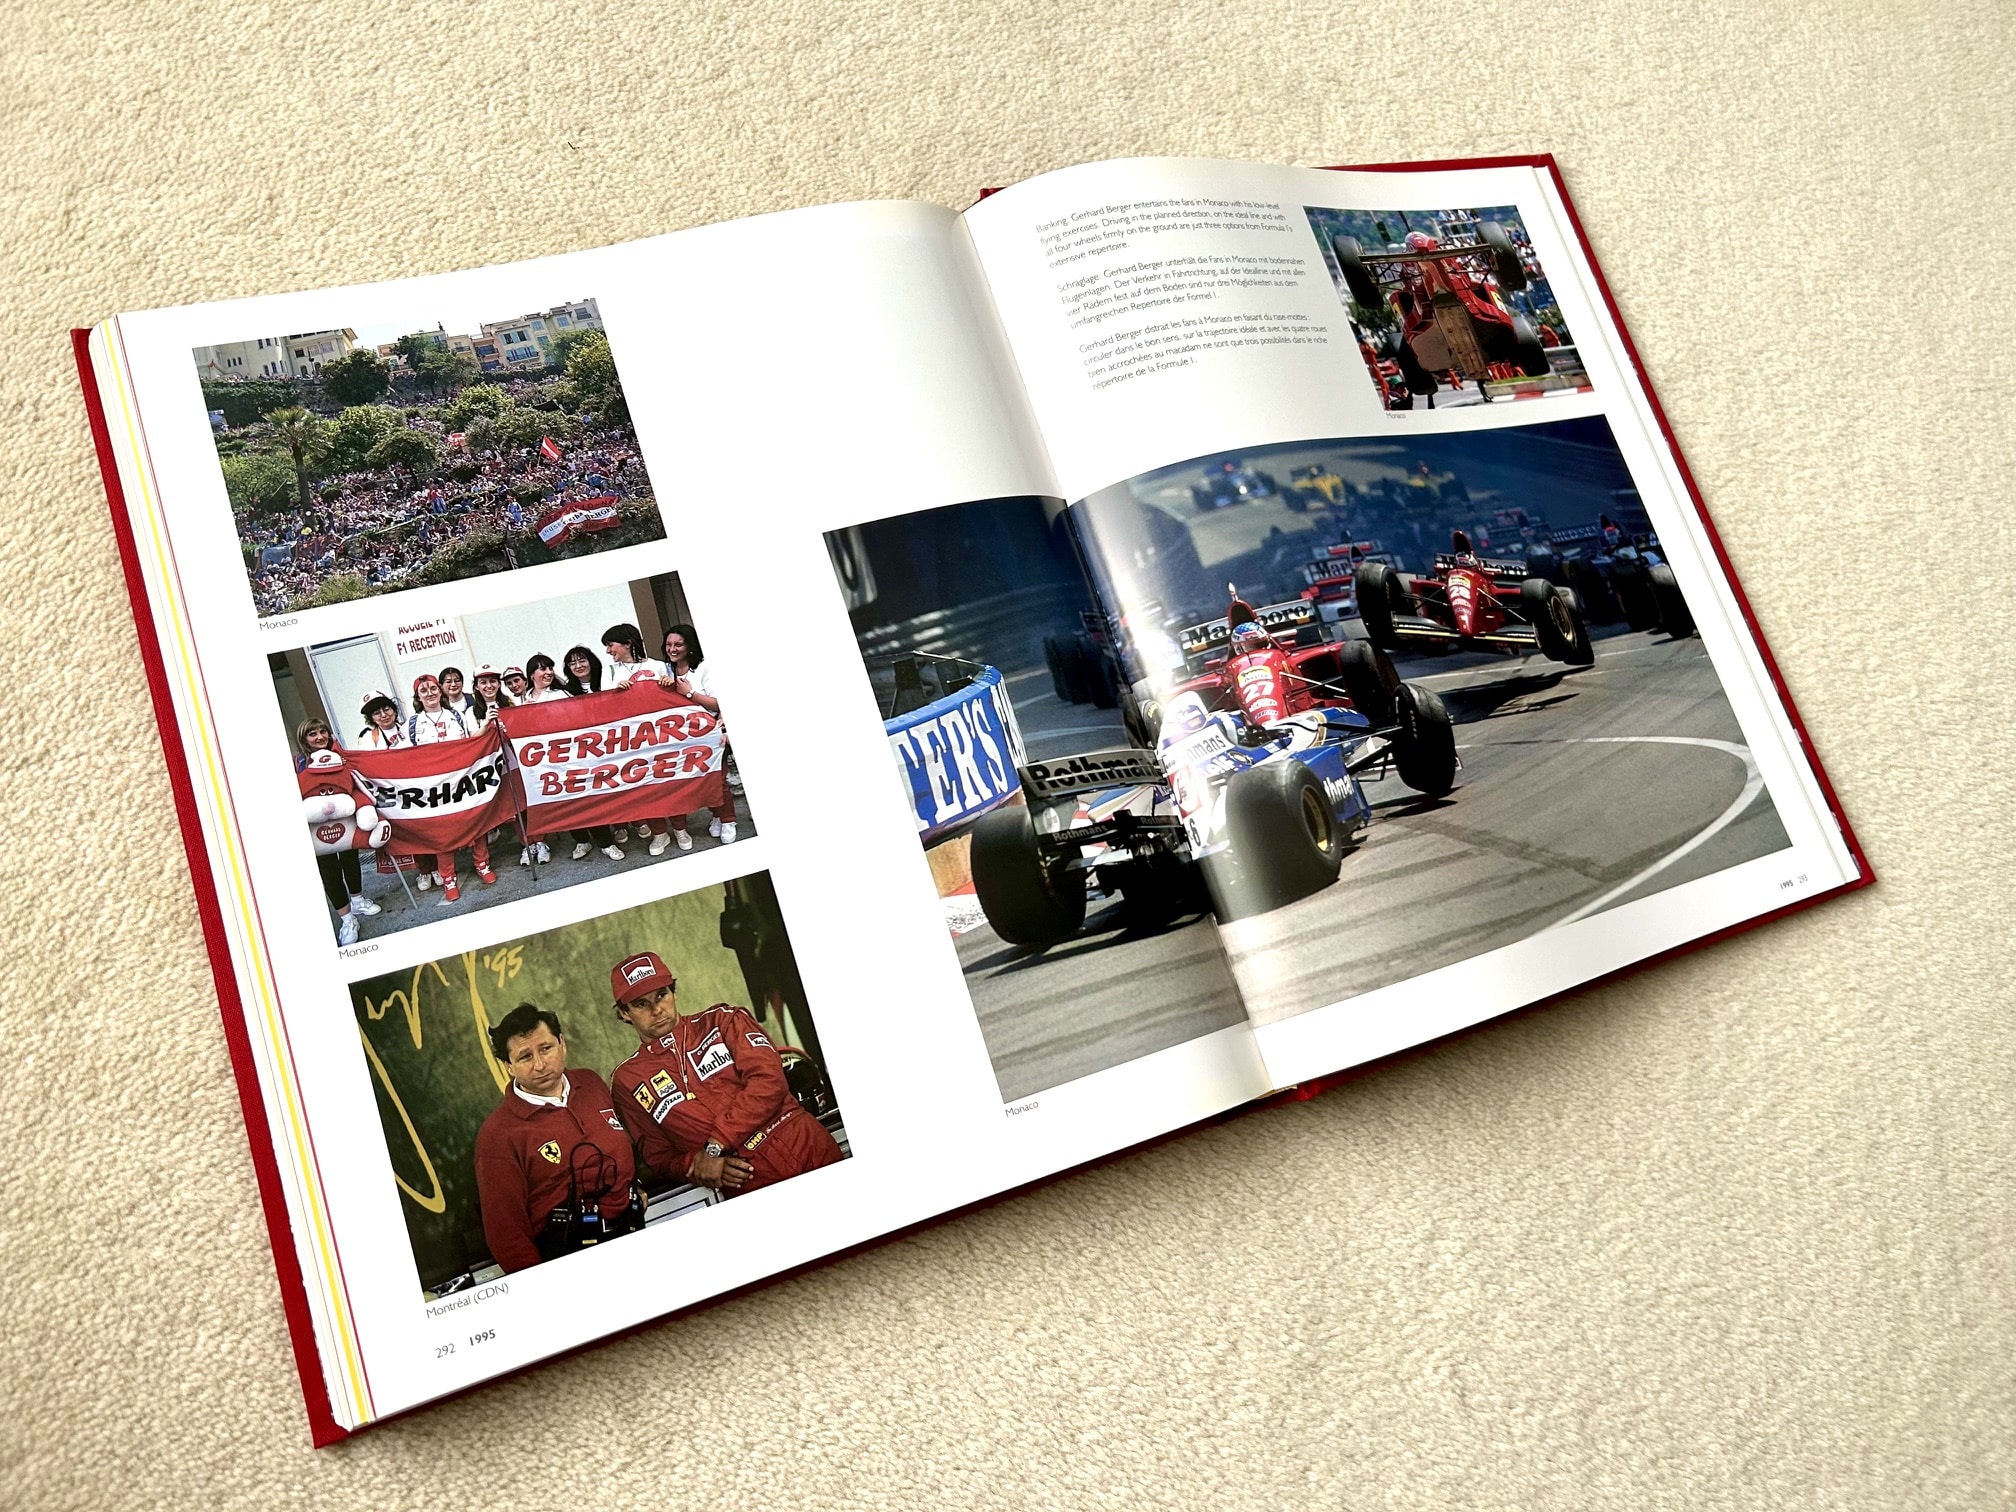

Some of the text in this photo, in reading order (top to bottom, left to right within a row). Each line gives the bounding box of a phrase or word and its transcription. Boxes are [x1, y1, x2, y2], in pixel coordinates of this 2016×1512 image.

[1071, 206, 1105, 221] Gerhard
[1106, 203, 1131, 214] Berger
[1134, 199, 1169, 210] entertains
[1181, 198, 1195, 207] fans
[1196, 198, 1202, 206] in
[1203, 199, 1229, 207] Monaco
[1101, 216, 1131, 227] Driving
[1139, 212, 1152, 220] the
[1154, 210, 1181, 221] planned
[1223, 211, 1234, 219] the
[1249, 211, 1260, 220] line
[1261, 212, 1272, 220] and
[1055, 243, 1072, 254] four
[1073, 234, 1102, 248] wheels
[1103, 228, 1125, 239] firmly
[1138, 225, 1151, 233] the
[1152, 223, 1178, 234] ground
[1179, 222, 1191, 230] are
[1191, 221, 1204, 231] just
[1204, 221, 1221, 229] three
[1222, 221, 1245, 230] options
[1245, 222, 1261, 231] from
[1049, 251, 1086, 269] extensive
[1103, 263, 1137, 278] Gerhard
[1138, 260, 1163, 271] Berger
[1165, 256, 1197, 268] unterhält
[1197, 255, 1208, 264] die
[1208, 255, 1224, 264] Fans
[1225, 256, 1231, 264] in
[1231, 255, 1258, 265] Monaco
[1258, 256, 1268, 264] mit
[1113, 278, 1131, 289] Der
[1131, 273, 1162, 285] Verkehr
[1219, 267, 1230, 275] auf
[1231, 267, 1241, 275] der
[1269, 267, 1281, 276] und
[1066, 306, 1081, 317] vier
[1114, 292, 1129, 302] fest
[1130, 287, 1142, 299] auf
[1143, 285, 1162, 296] dem
[1162, 281, 1188, 292] Boden
[1188, 278, 1202, 289] sind
[1203, 279, 1215, 288] nur
[1216, 277, 1230, 287] drei
[1273, 278, 1284, 287] aus
[1285, 279, 1299, 287] dem
[1070, 305, 1129, 330] umfangreichen
[1130, 297, 1171, 311] Repertoire
[1172, 294, 1185, 303] der
[1186, 291, 1212, 302] Formel
[1079, 335, 1115, 354] Gerhard
[1115, 328, 1143, 342] Berger
[1144, 322, 1170, 334] distrait
[1170, 320, 1182, 329] les
[1182, 318, 1197, 327] fans
[1198, 317, 1204, 325] à
[1204, 315, 1233, 325] Monaco
[1233, 314, 1243, 322] en
[1264, 313, 1273, 321] du
[1083, 351, 1113, 366] circuler
[1115, 344, 1134, 356] dans
[1135, 341, 1143, 349] le
[1144, 337, 1161, 348] bon
[1183, 331, 1194, 340] sur
[1196, 329, 1203, 338] la
[1203, 326, 1238, 338] trajectoire
[1281, 324, 1291, 333] les
[1291, 326, 1309, 334] quatre
[1154, 351, 1164, 359] au
[1165, 342, 1202, 356] macadam
[1203, 342, 1213, 350] ne
[1214, 339, 1229, 348] sont
[1231, 339, 1243, 348] que
[1244, 337, 1259, 346] trois
[1292, 336, 1305, 344] dans
[1305, 336, 1313, 344] le
[1135, 367, 1147, 377] de
[1147, 365, 1155, 373] la
[1155, 357, 1189, 372] Formule
[259, 618, 298, 631] Monaco
[396, 630, 457, 656] F1 RECEPTION
[1242, 680, 1275, 704] 27
[518, 711, 718, 767] GERHARD
[538, 744, 714, 797] BERGER
[1052, 824, 1108, 842] Rothmans
[1779, 879, 1794, 890] 1995
[338, 944, 379, 960] Monaco
[628, 968, 655, 984] Marlboro
[1004, 1101, 1039, 1118] Monaco
[747, 1132, 763, 1149] OMP
[426, 1282, 509, 1319] Montréal (CDN)
[435, 1328, 496, 1359] 292 1995
